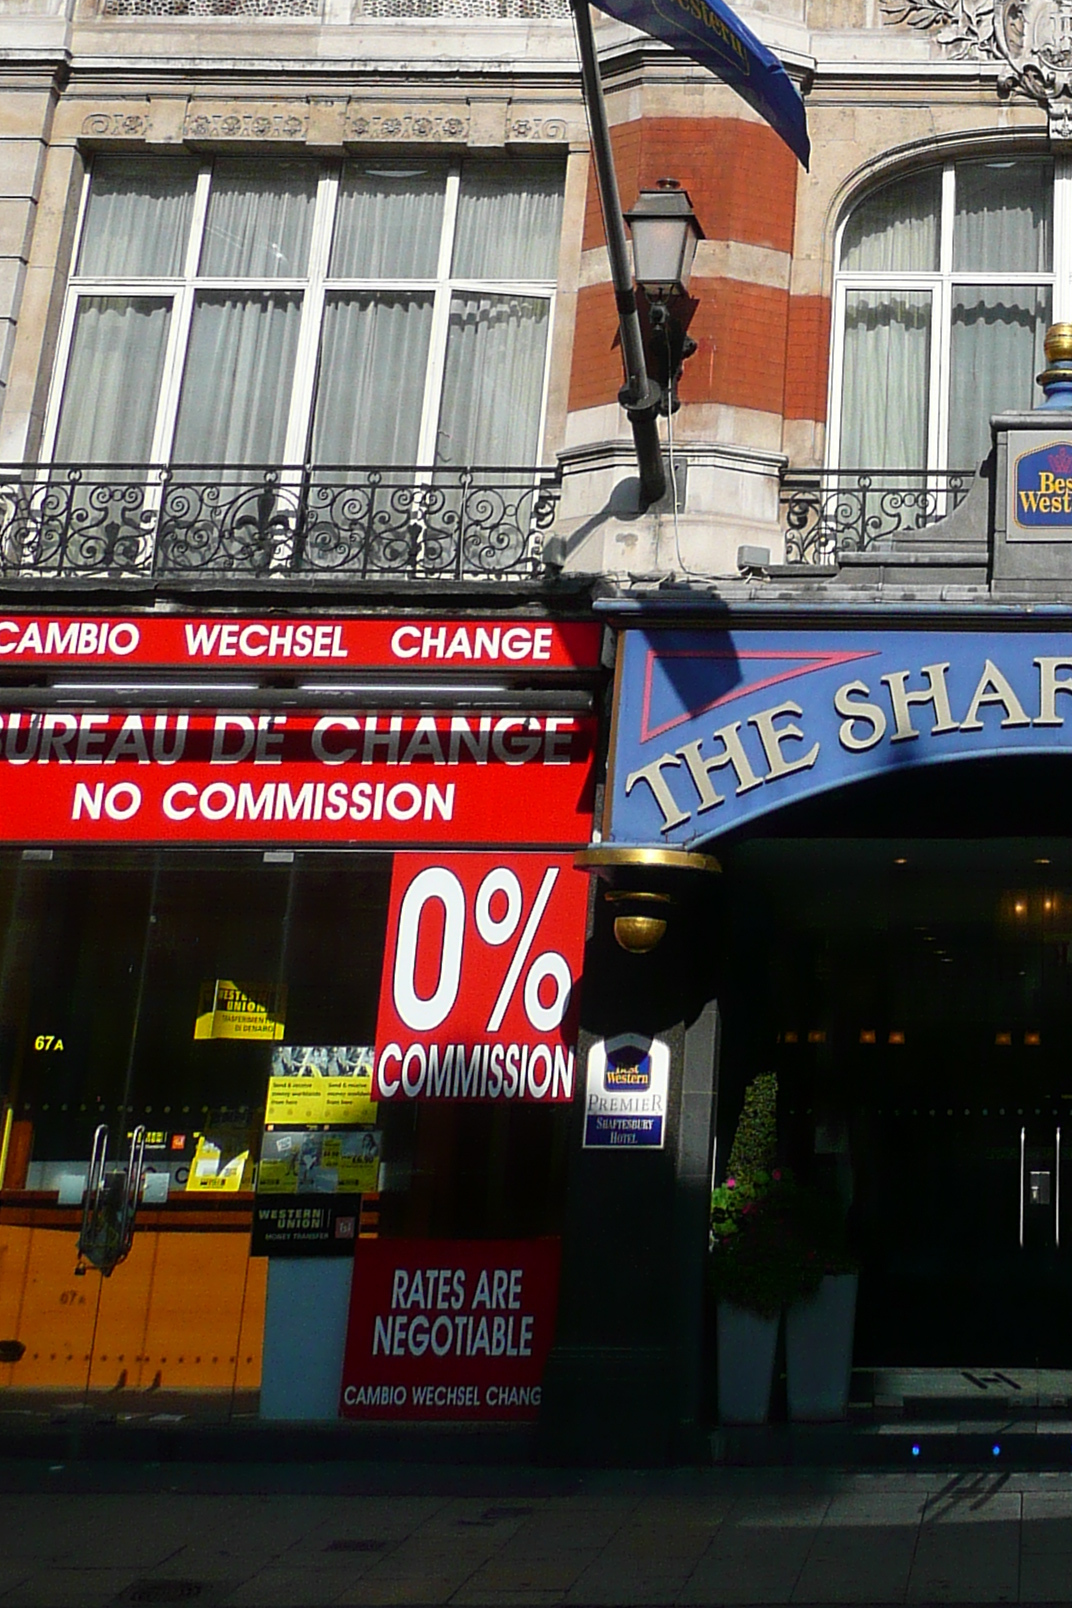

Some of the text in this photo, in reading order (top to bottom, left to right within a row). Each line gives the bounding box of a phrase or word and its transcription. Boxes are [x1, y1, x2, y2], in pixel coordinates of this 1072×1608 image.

[0, 621, 553, 661] CAMBIO WECHSEL CHANGE
[0, 710, 574, 766] UREAU DE CHANGE
[625, 700, 820, 833] THE
[71, 782, 456, 821] NO COMMISSION
[393, 866, 573, 1032] 0%
[378, 1043, 574, 1098] COMMISSION
[607, 1072, 648, 1084] Western
[588, 1094, 663, 1112] PREMIER
[596, 1117, 654, 1130] SHAFTESBURY
[610, 1132, 638, 1143] HOTEL
[258, 1209, 321, 1219] WESTERN
[277, 1219, 320, 1229] UNION
[392, 1269, 523, 1309] RATES ARE
[372, 1315, 534, 1356] NEGOTIABLE
[344, 1386, 407, 1406] CAMBIO
[412, 1386, 481, 1406] WECHSEL
